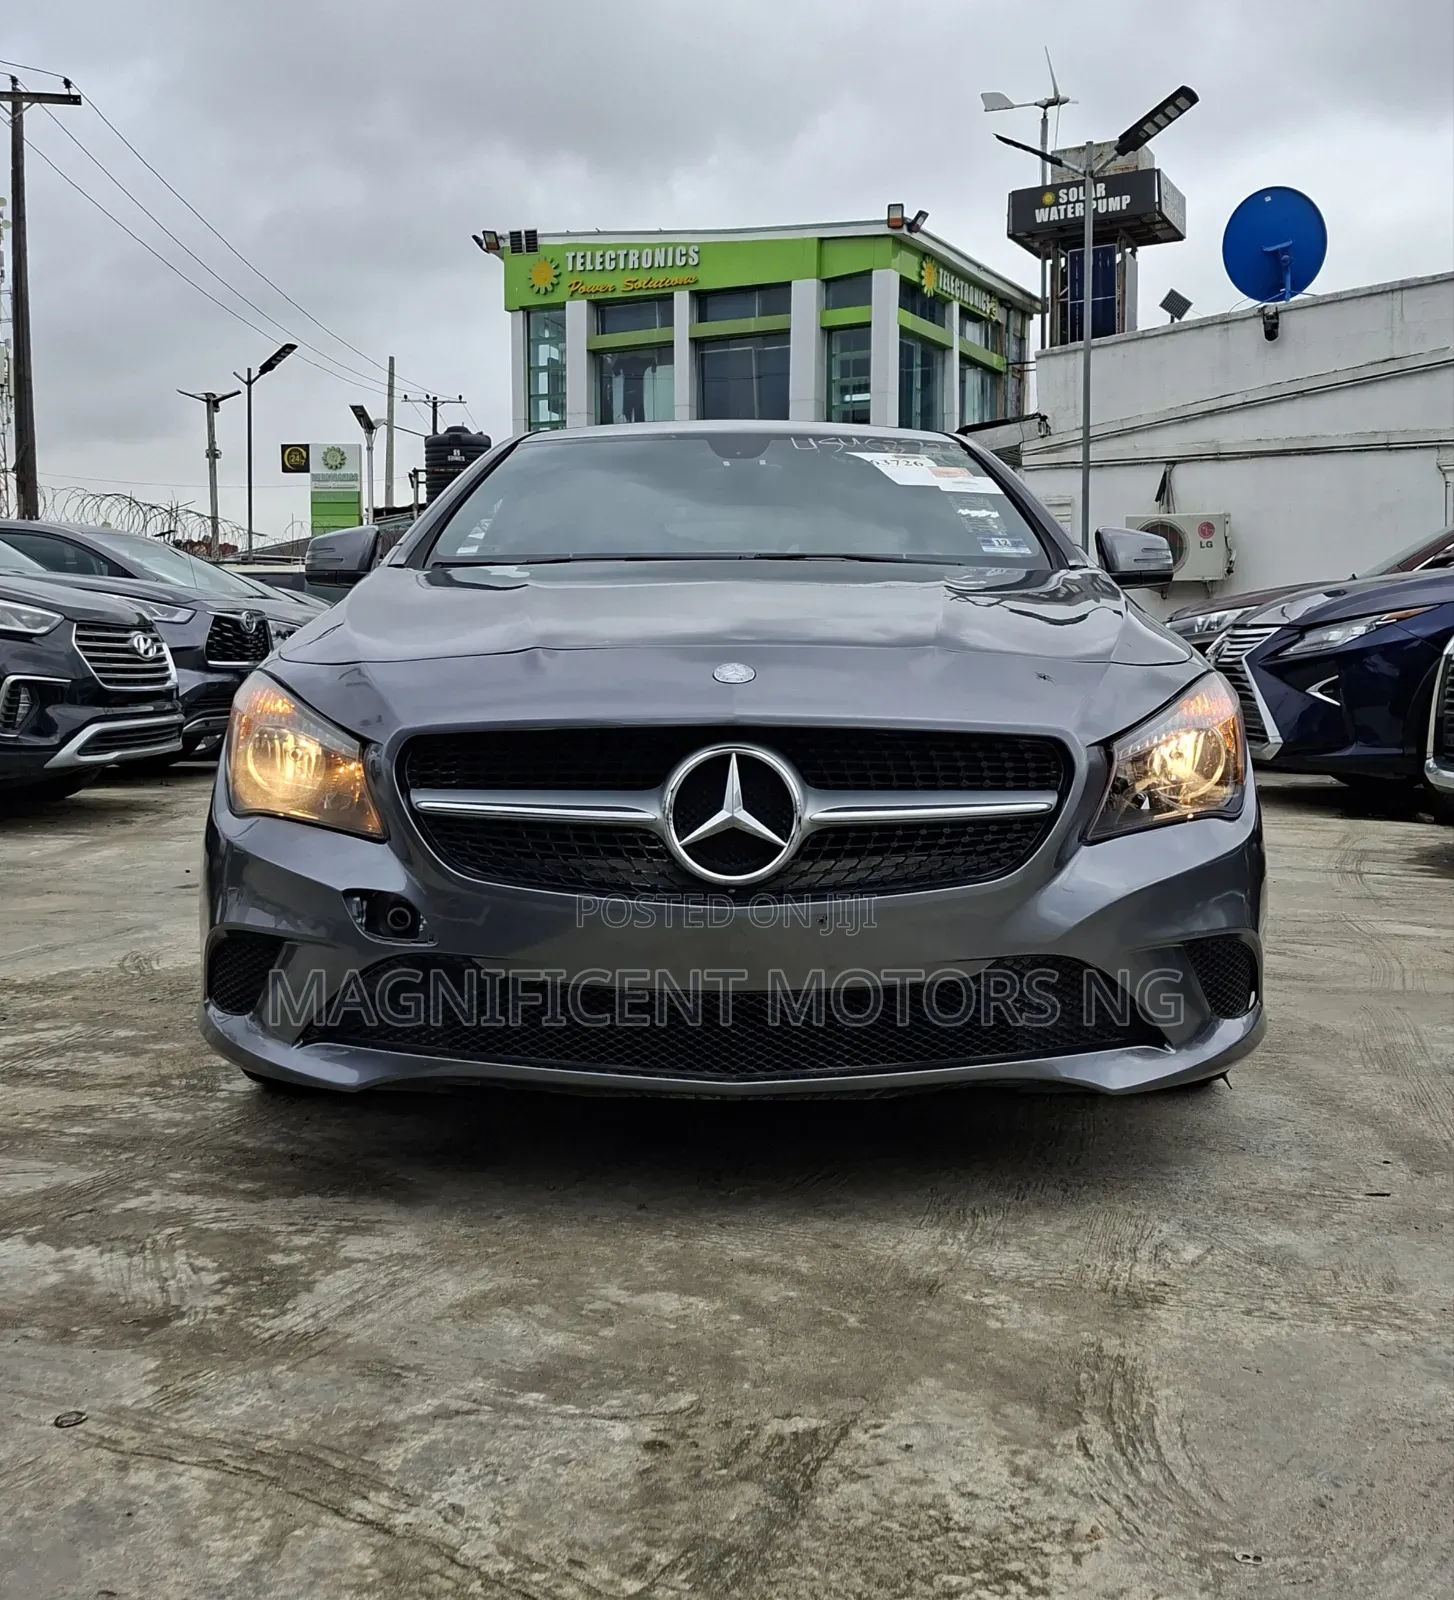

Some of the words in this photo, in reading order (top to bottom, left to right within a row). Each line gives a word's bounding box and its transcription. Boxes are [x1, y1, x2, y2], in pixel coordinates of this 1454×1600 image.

[1035, 204, 1085, 223] WATER
[566, 245, 700, 272] TELECTRONICS
[568, 279, 616, 296] Power
[620, 274, 698, 292] Solutions
[939, 267, 991, 314] TELECTRONICS
[871, 459, 924, 467] 63726
[1199, 540, 1213, 548] LG
